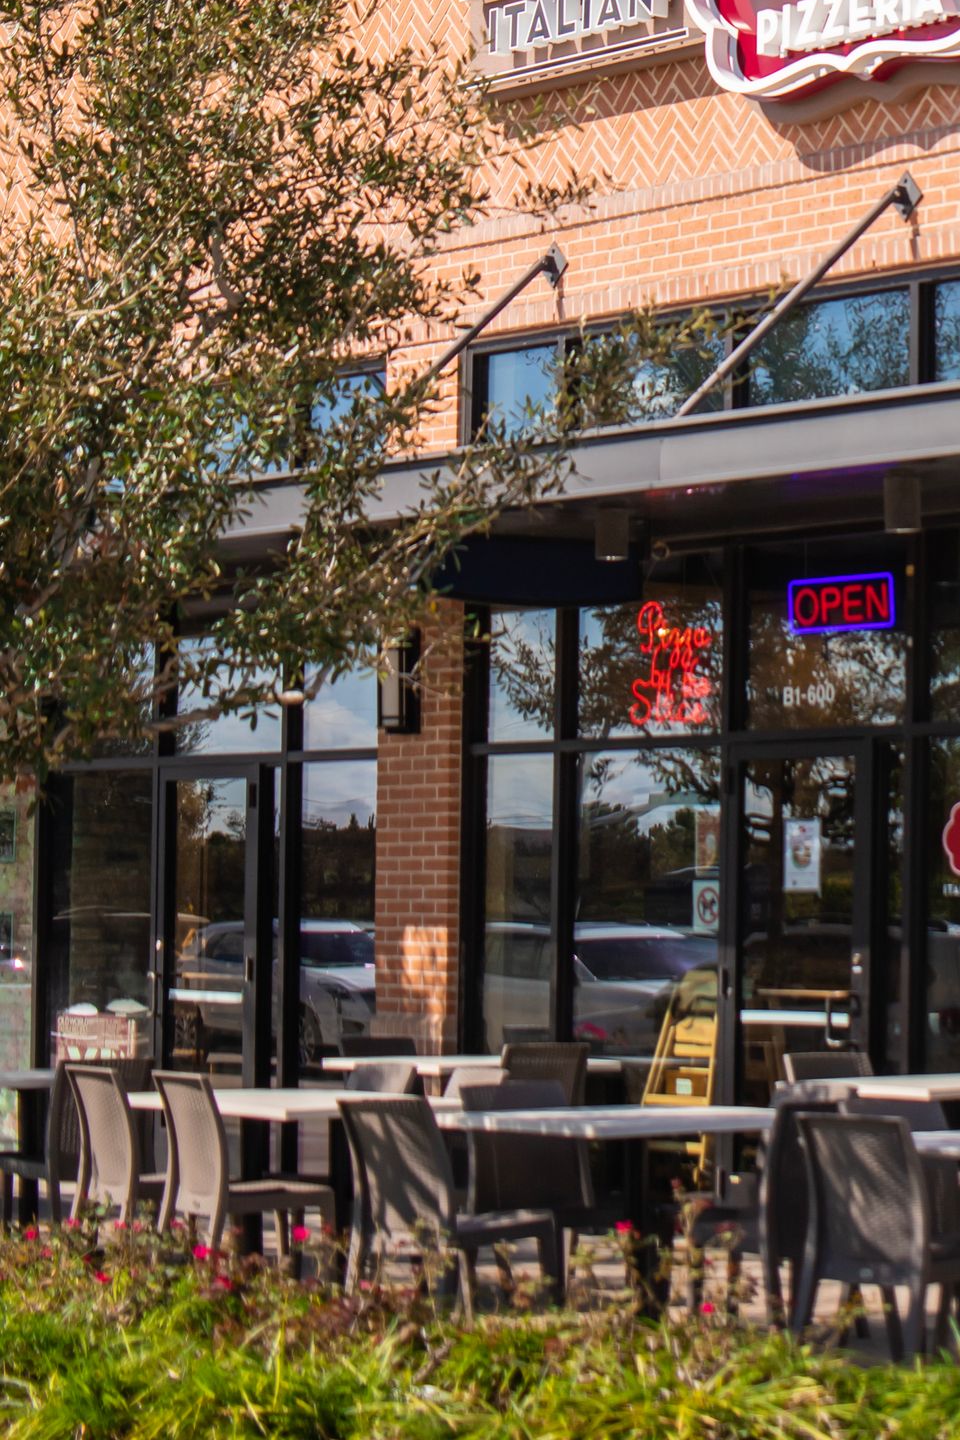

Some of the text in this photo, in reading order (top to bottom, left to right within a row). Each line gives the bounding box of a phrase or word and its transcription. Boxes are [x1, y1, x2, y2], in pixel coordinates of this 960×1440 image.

[794, 579, 889, 627] OPEN
[637, 600, 712, 669] Pizza
[782, 681, 836, 708] B1-600
